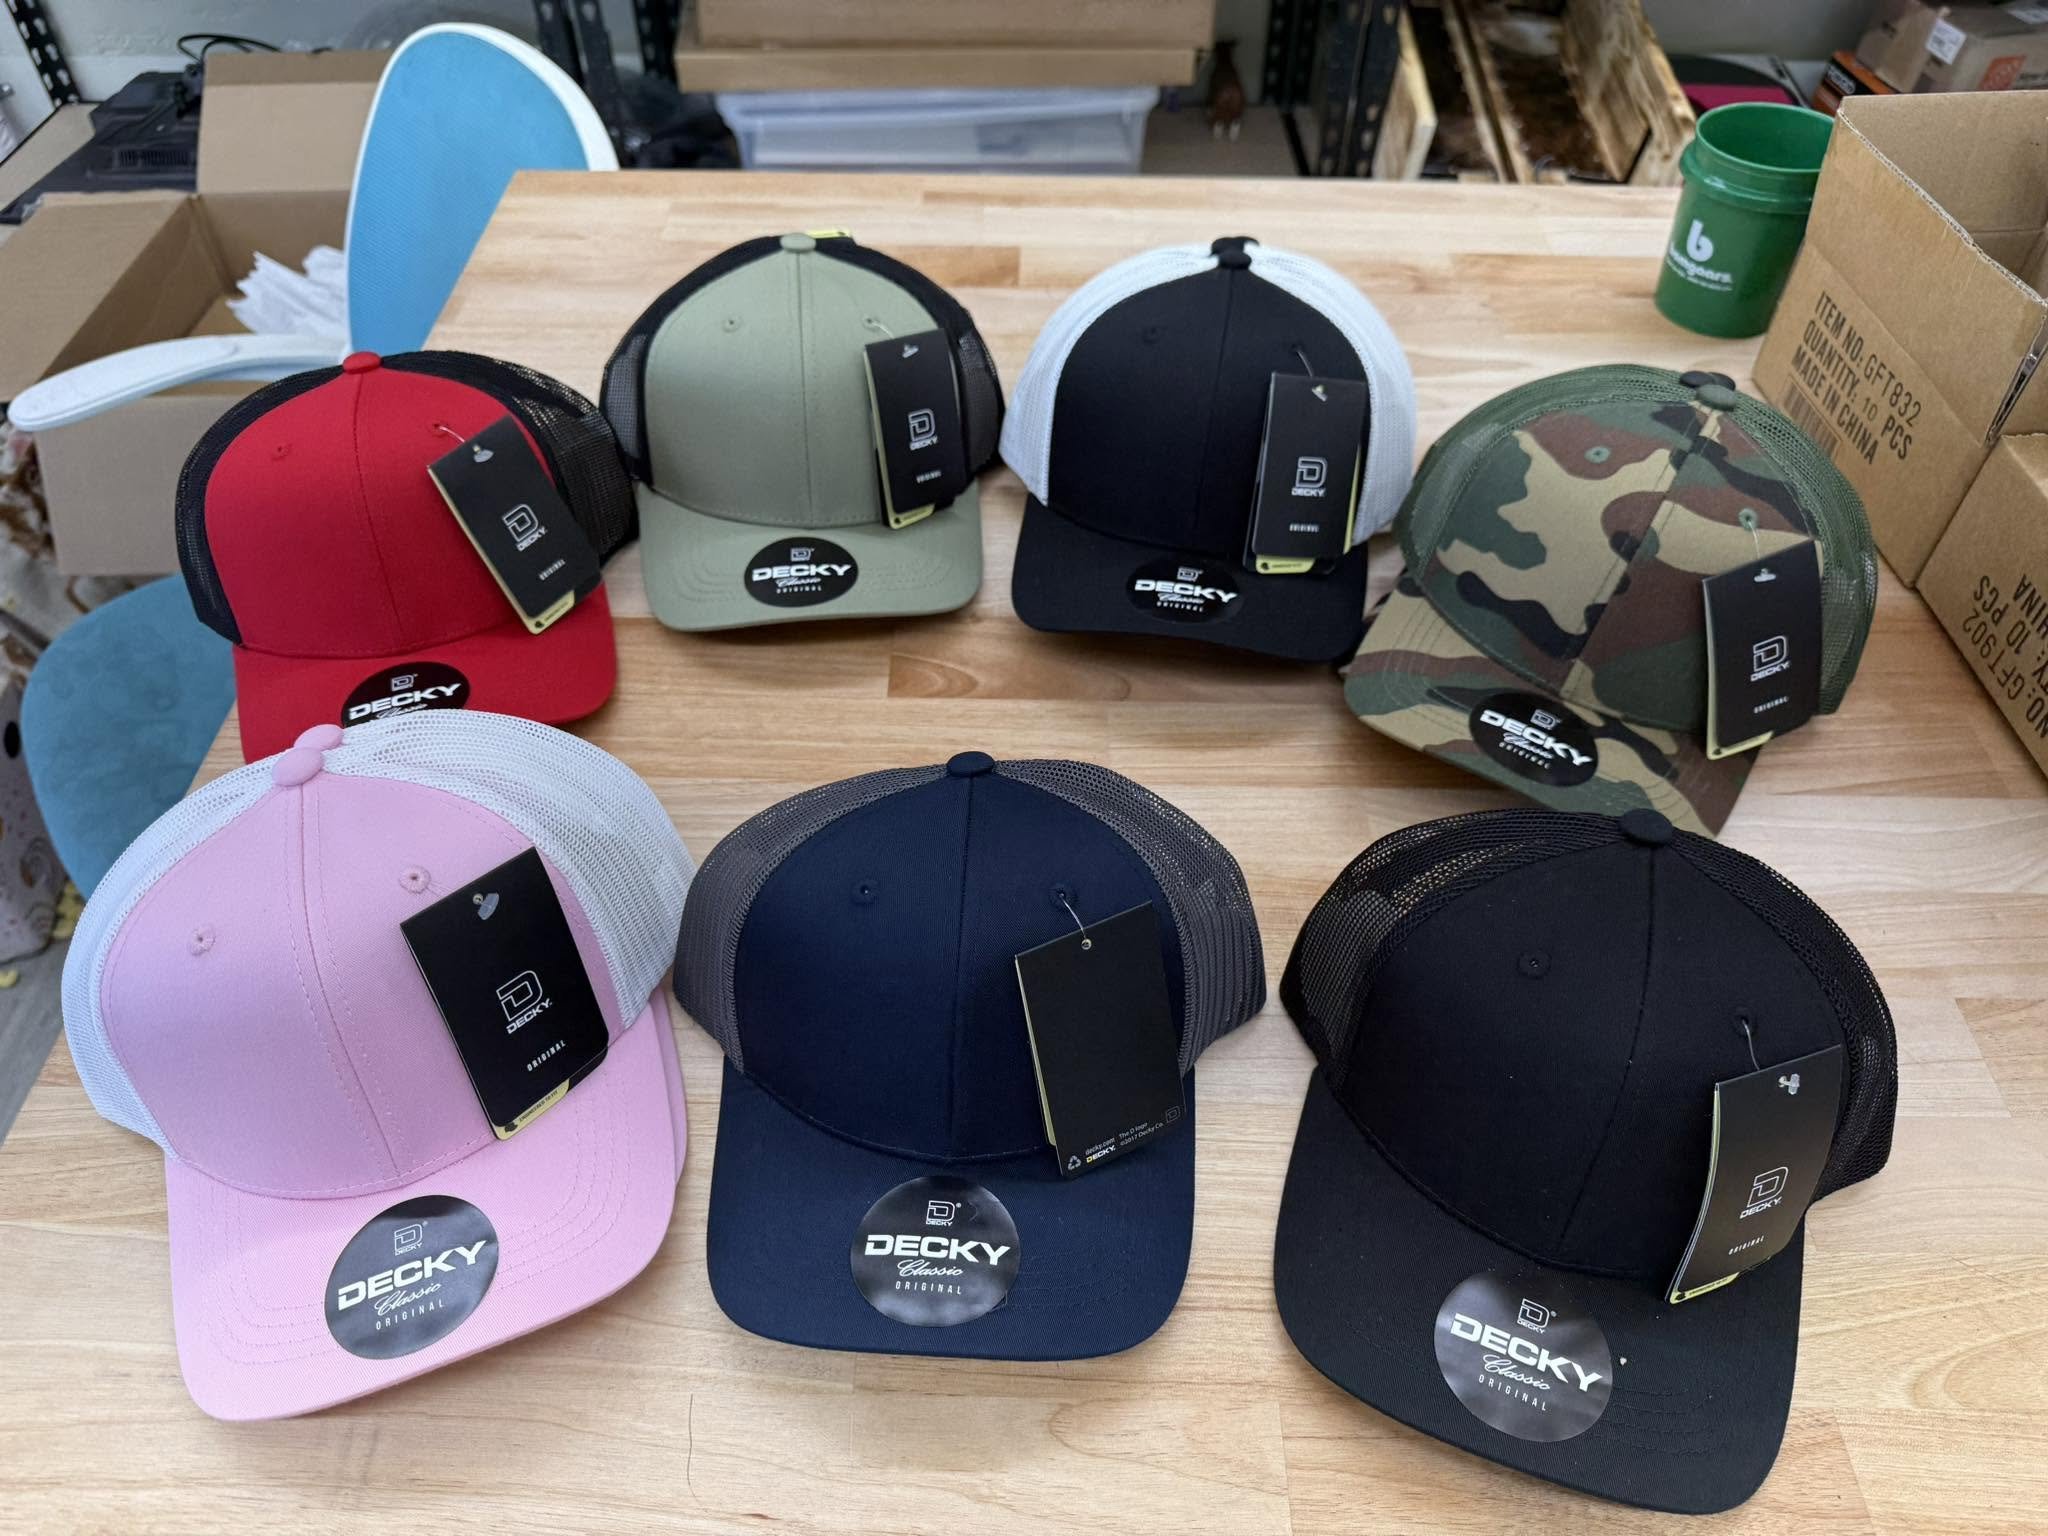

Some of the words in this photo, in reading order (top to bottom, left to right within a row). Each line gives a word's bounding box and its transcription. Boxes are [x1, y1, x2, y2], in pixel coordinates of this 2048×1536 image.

[1686, 219, 1714, 262] b
[1815, 291, 1846, 339] ITEM
[1842, 326, 1864, 368] NO:
[1864, 354, 1921, 427] GFT832
[1792, 344, 1826, 397] MADE
[1822, 384, 1840, 416] IN
[1837, 404, 1879, 464] CHINA
[1804, 320, 1860, 402] QUANTITY:
[1862, 398, 1878, 421] 10
[1881, 415, 1912, 460] PCS
[1292, 487, 1326, 497] DECKY
[752, 564, 851, 582] DECKY
[1134, 579, 1238, 603] DECKY
[1973, 575, 2010, 626] PCS
[2013, 574, 2048, 640] HINA
[1962, 608, 2025, 700] GFT902
[2006, 620, 2031, 655] 10
[1750, 660, 1790, 682] DECKY
[348, 683, 461, 720] DECKY
[1480, 709, 1593, 766] DECKY
[506, 998, 551, 1034] DECKY
[527, 1039, 566, 1072] ORIGINAL
[1086, 1145, 1114, 1164] DECKY
[1739, 1197, 1782, 1220] DECKY
[394, 1242, 423, 1256] DECKY
[864, 1234, 1010, 1266] DECKY
[1728, 1236, 1764, 1255] ORIGINAL
[338, 1240, 487, 1311] DECKY
[897, 1259, 964, 1278] Classic
[374, 1282, 442, 1316] Classic
[896, 1281, 962, 1295] ORIGINAL
[376, 1300, 444, 1330] ORIGINAL
[1517, 1319, 1545, 1334] DECKY
[1450, 1312, 1603, 1392] DECKY
[1482, 1354, 1551, 1390] Classic
[1478, 1374, 1547, 1411] ORIGINAL
